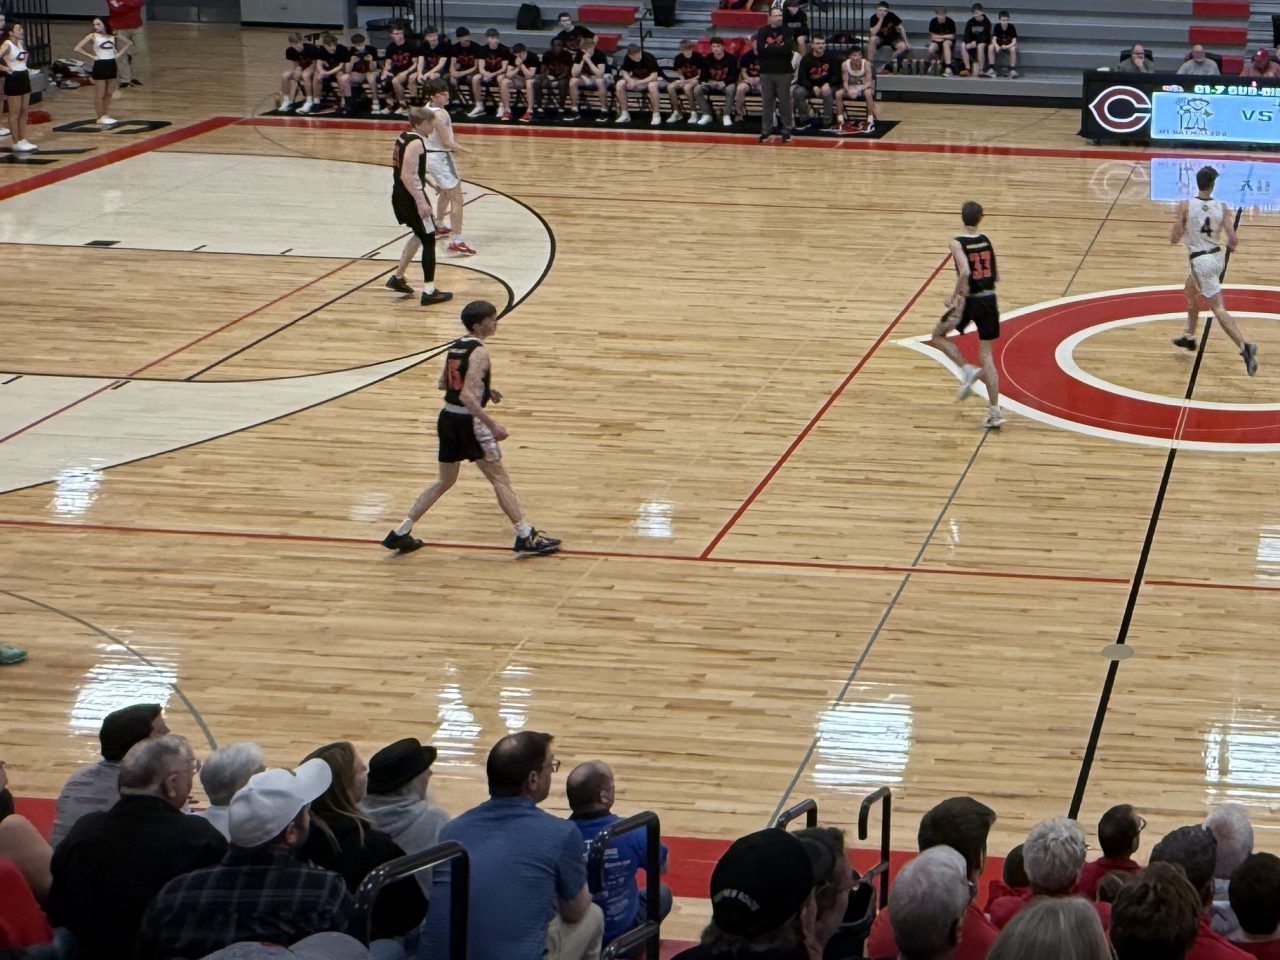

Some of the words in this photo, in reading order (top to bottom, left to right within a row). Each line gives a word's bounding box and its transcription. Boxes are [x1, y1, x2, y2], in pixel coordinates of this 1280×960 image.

[1241, 109, 1272, 122] VS
[1200, 216, 1212, 238] 4
[969, 250, 992, 279] 33
